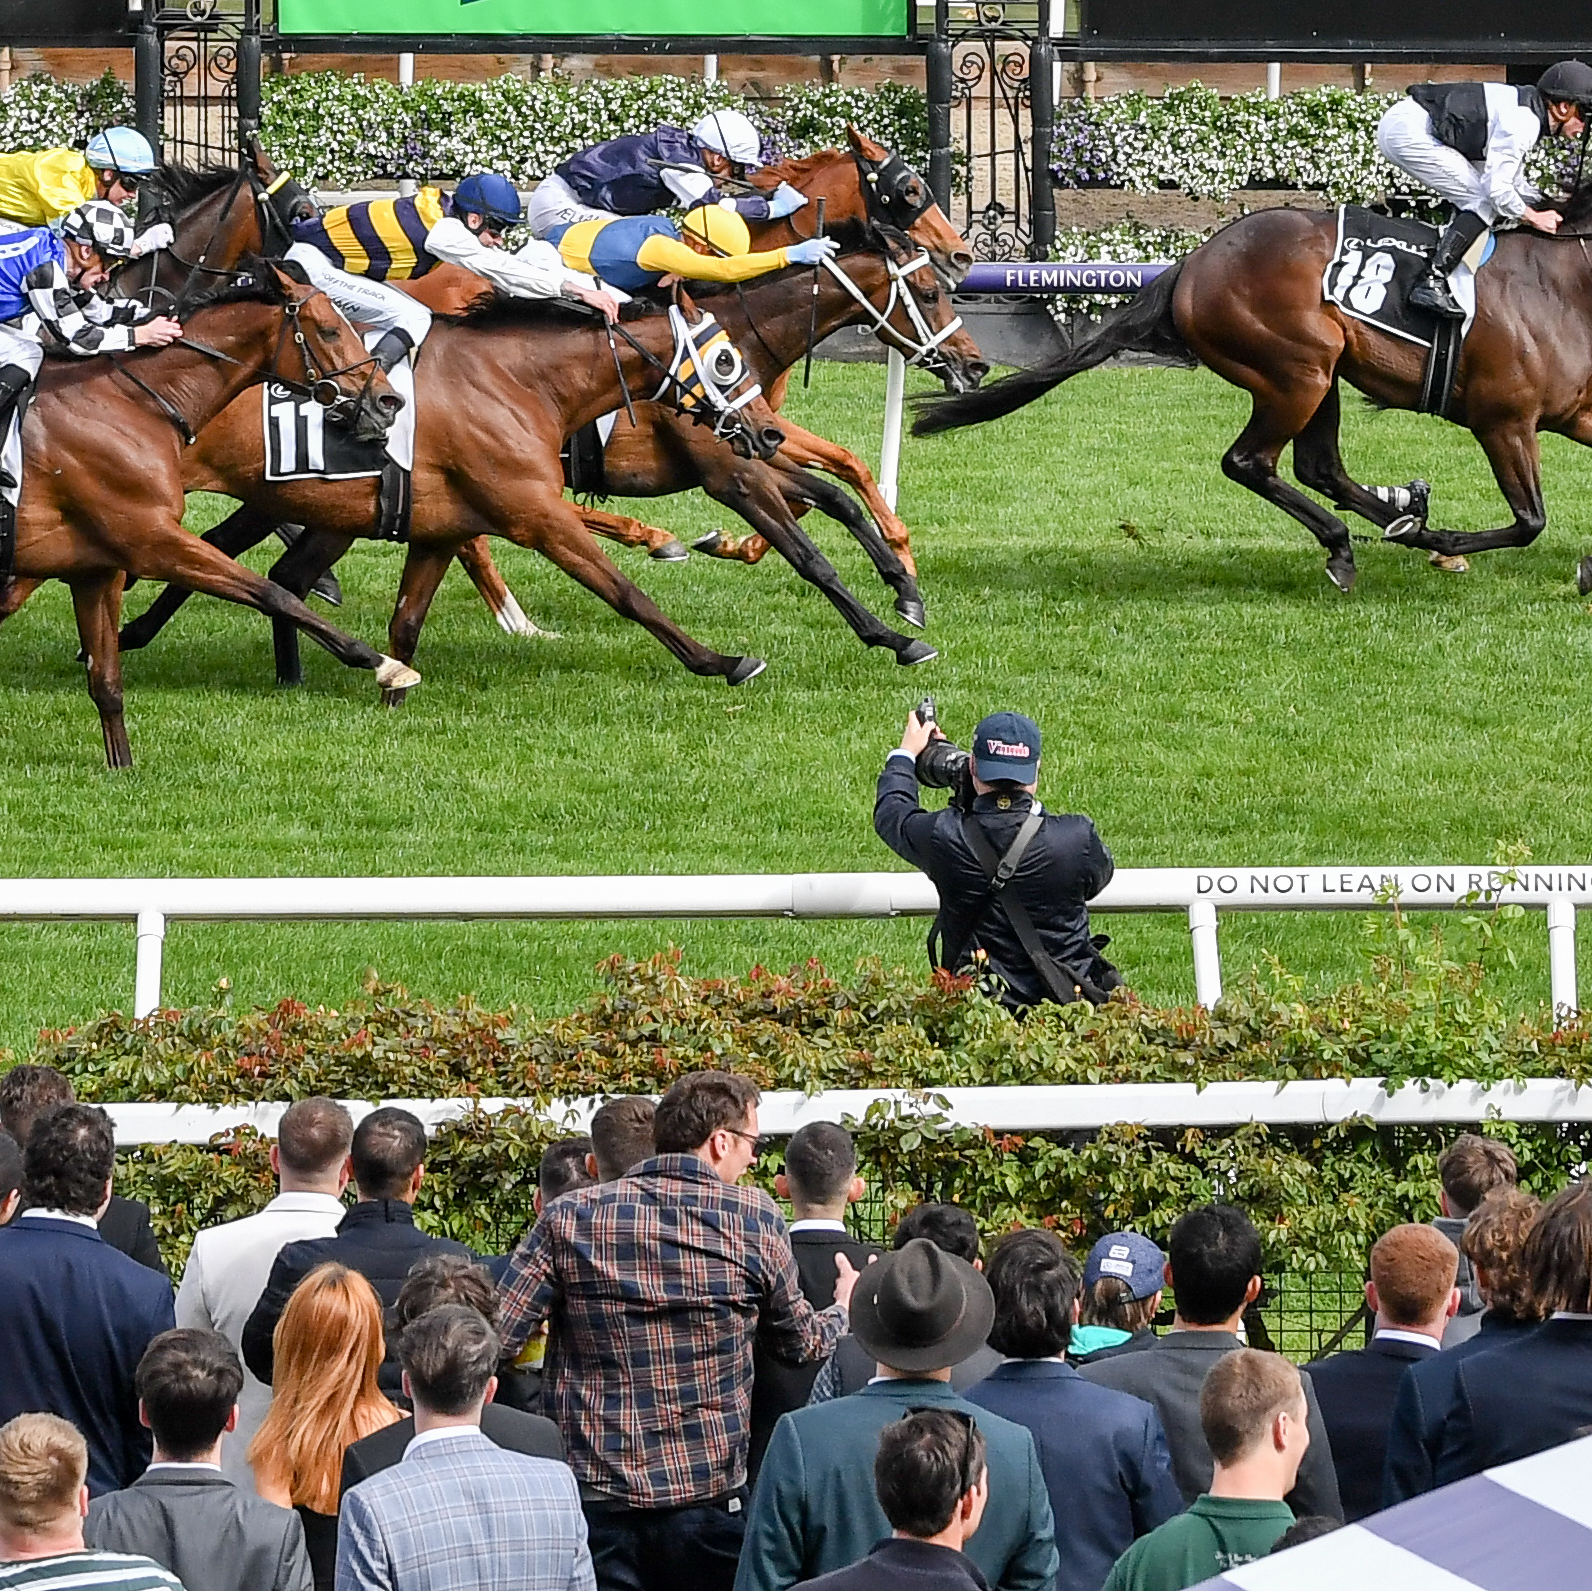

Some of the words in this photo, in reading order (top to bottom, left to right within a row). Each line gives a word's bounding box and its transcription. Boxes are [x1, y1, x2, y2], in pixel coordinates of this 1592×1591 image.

[1005, 269, 1142, 288] FLEMINGTON
[1333, 250, 1396, 315] 18
[270, 401, 325, 474] 11
[1196, 874, 1238, 895] DO
[1250, 874, 1309, 895] NOT
[1412, 873, 1455, 894] ON
